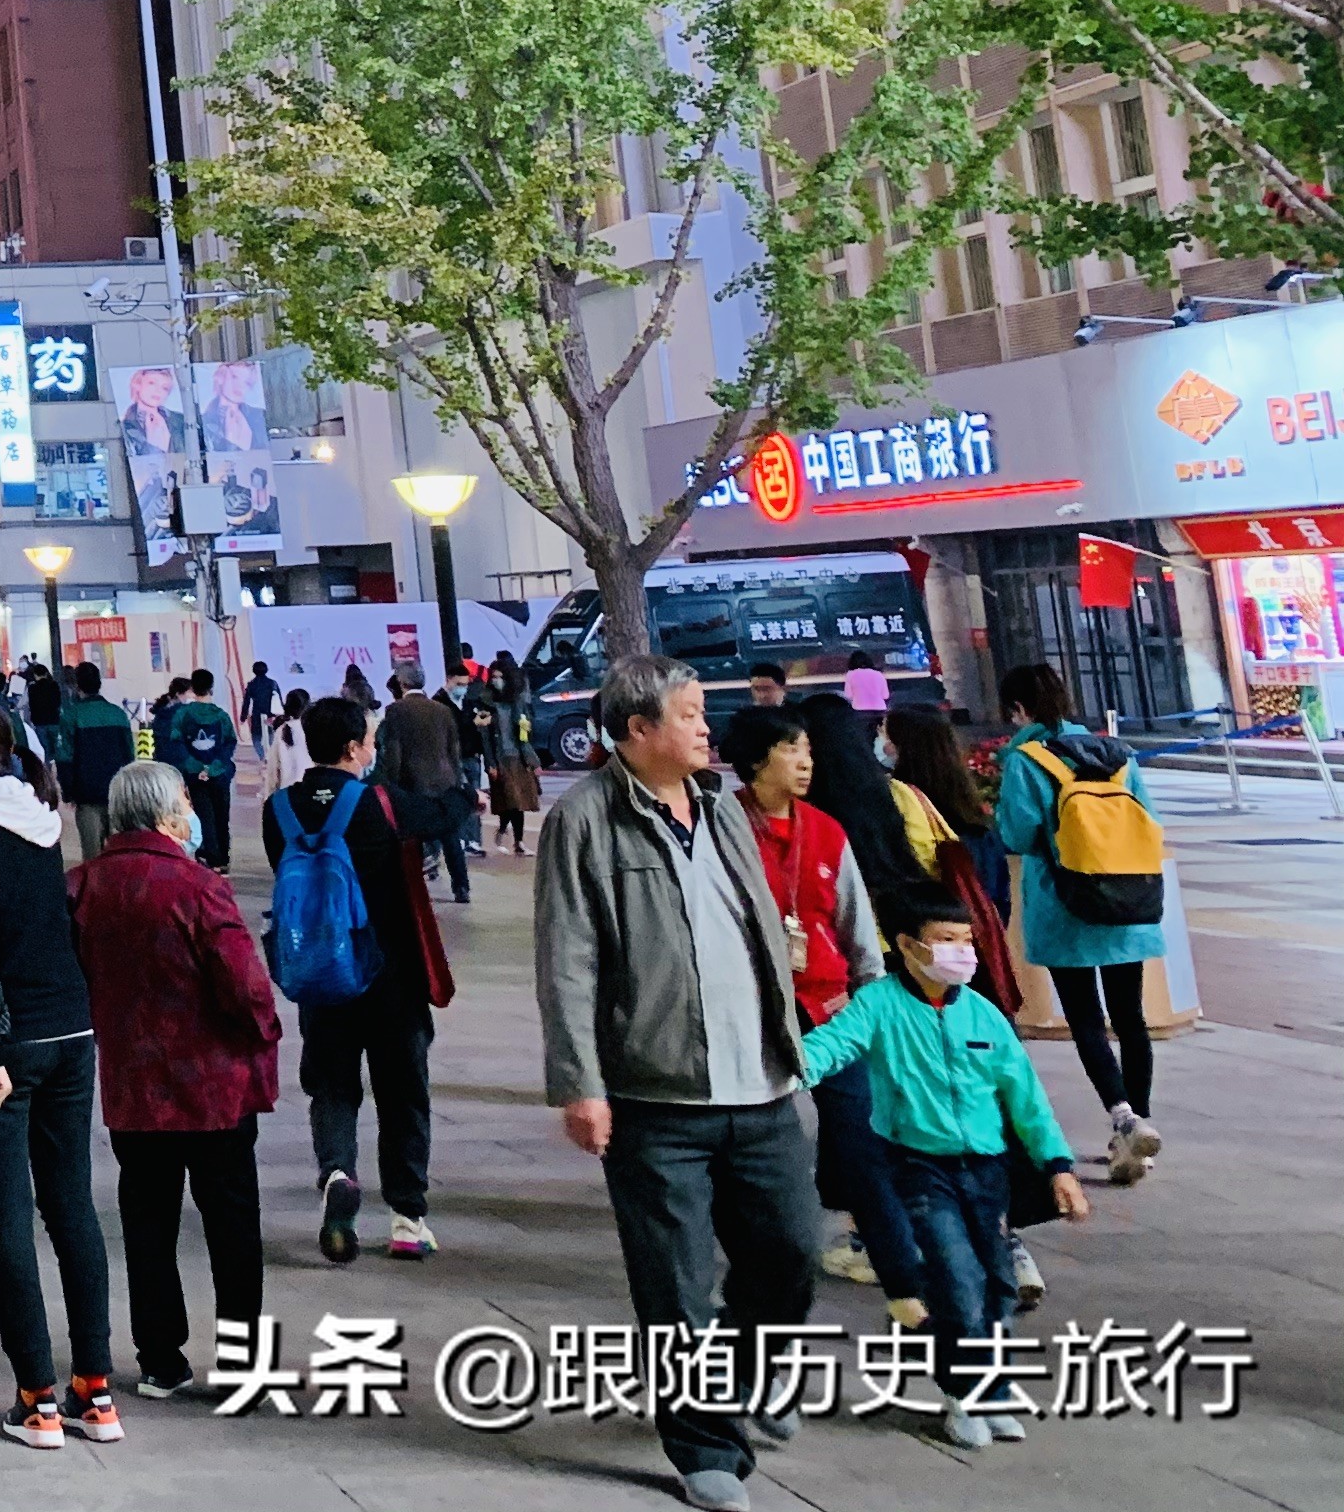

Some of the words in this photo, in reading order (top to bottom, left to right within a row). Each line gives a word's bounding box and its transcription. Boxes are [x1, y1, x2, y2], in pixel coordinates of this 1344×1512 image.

[30, 336, 87, 393] 药
[1266, 390, 1344, 446] BEI
[802, 411, 994, 495] 中国工商银行
[1247, 517, 1333, 551] 北京
[748, 618, 818, 642] 武装押运
[836, 613, 906, 637] 请勿靠近
